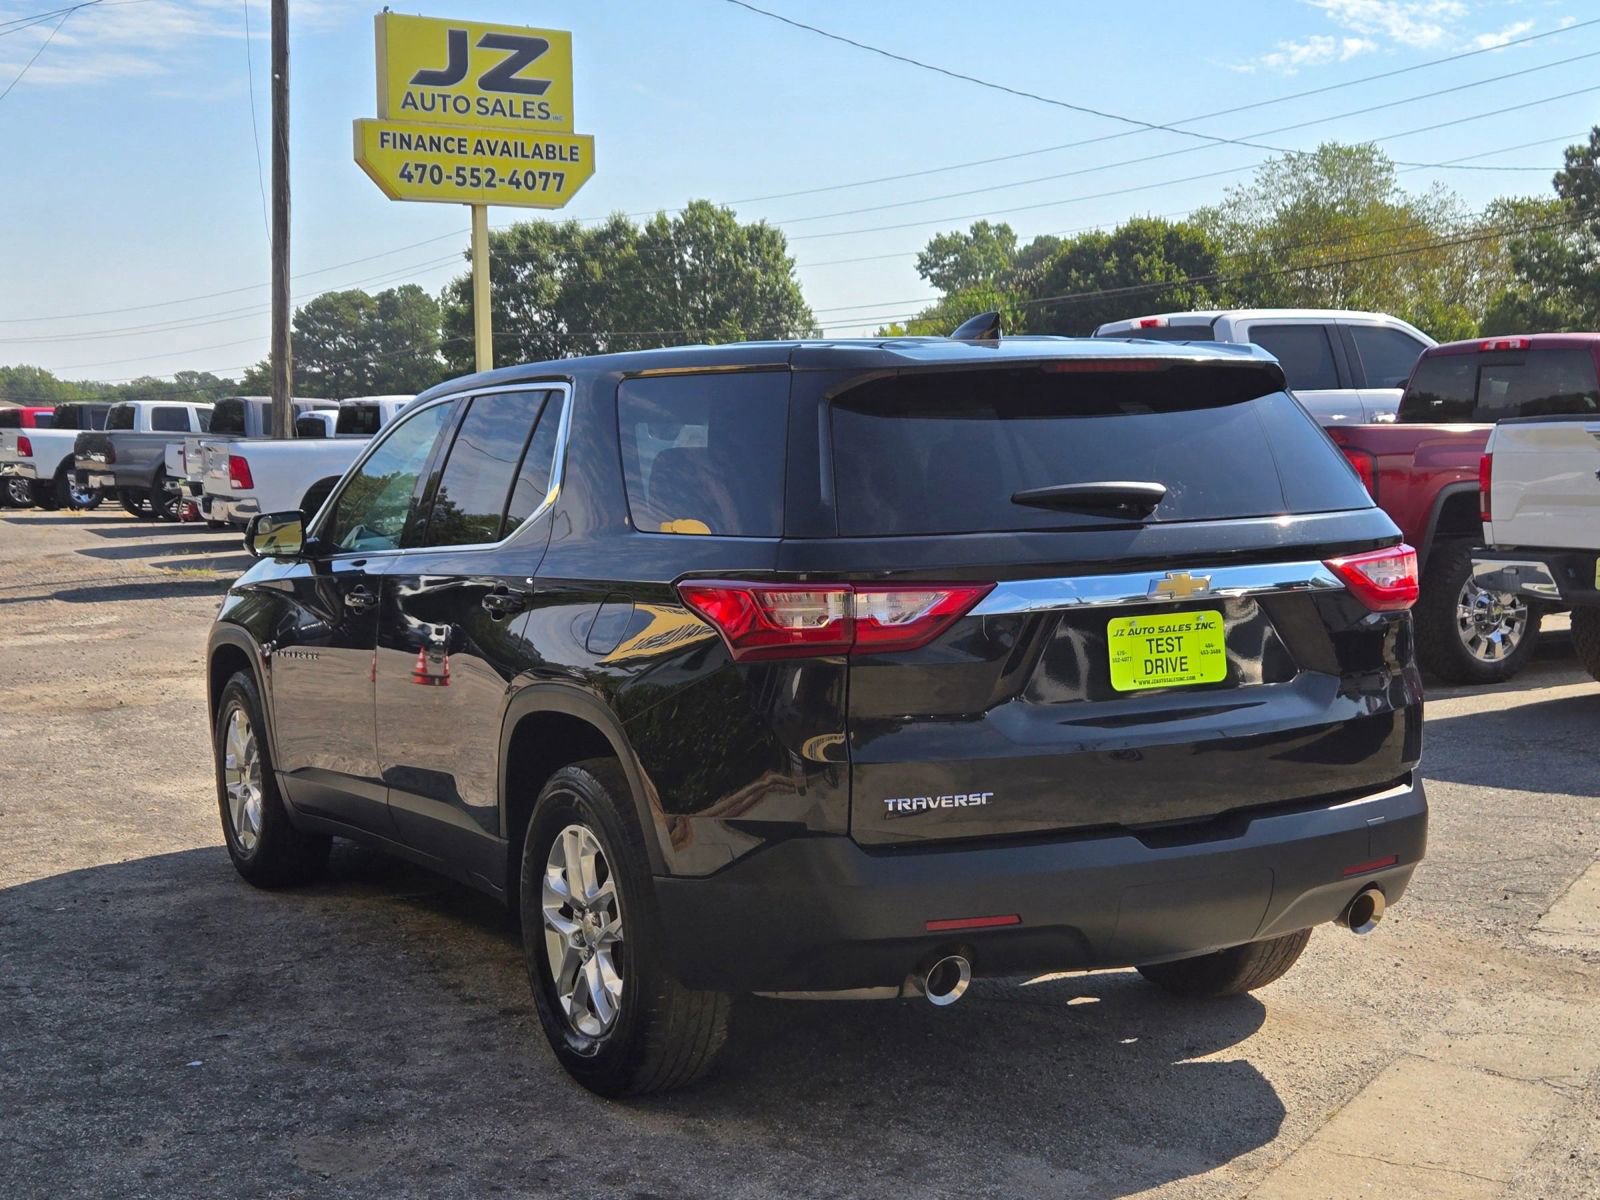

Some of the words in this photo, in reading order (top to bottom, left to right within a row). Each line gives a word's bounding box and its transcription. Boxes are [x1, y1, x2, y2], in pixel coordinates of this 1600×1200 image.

[409, 29, 552, 96] JZ
[401, 91, 471, 115] AUTO
[476, 97, 551, 120] SALES
[380, 131, 468, 155] FINANCE
[473, 139, 580, 163] AVAILABLE
[399, 163, 565, 192] 470-552-4077
[1113, 628, 1125, 637] JZ
[1128, 625, 1155, 636] AUTO
[1158, 623, 1191, 634] SALES
[1194, 621, 1216, 631] INC.
[1146, 636, 1184, 655] TEST
[1144, 656, 1189, 676] DRIVE
